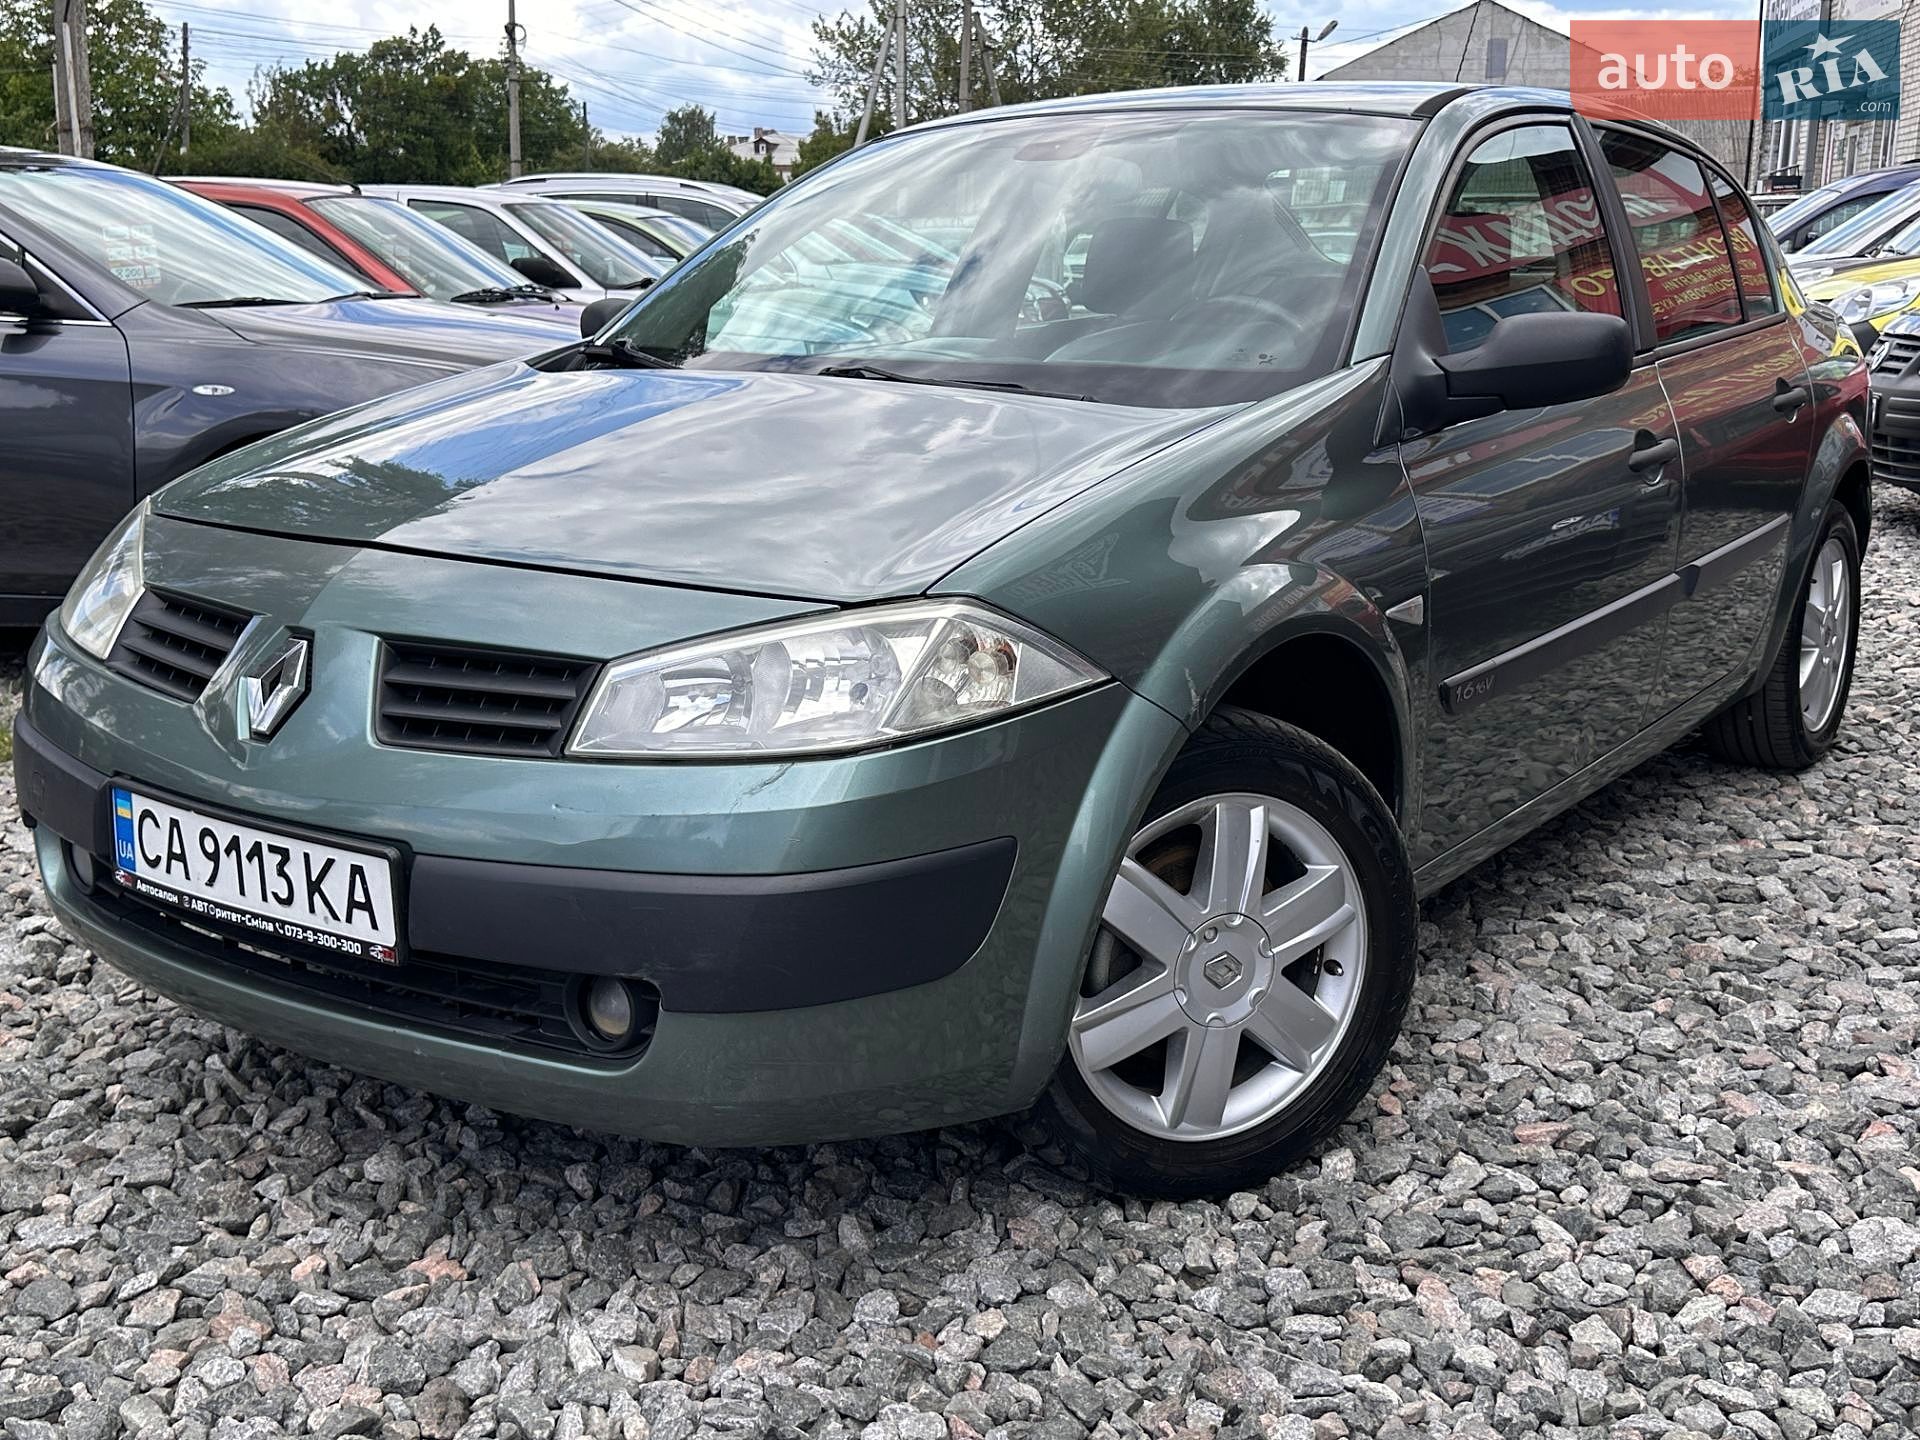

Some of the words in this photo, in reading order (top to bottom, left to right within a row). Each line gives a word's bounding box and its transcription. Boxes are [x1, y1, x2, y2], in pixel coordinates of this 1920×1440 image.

[119, 840, 134, 861] UA
[199, 827, 295, 908] 9113
[137, 879, 179, 904] Автосалон
[285, 925, 362, 955] 073-9-300-300
